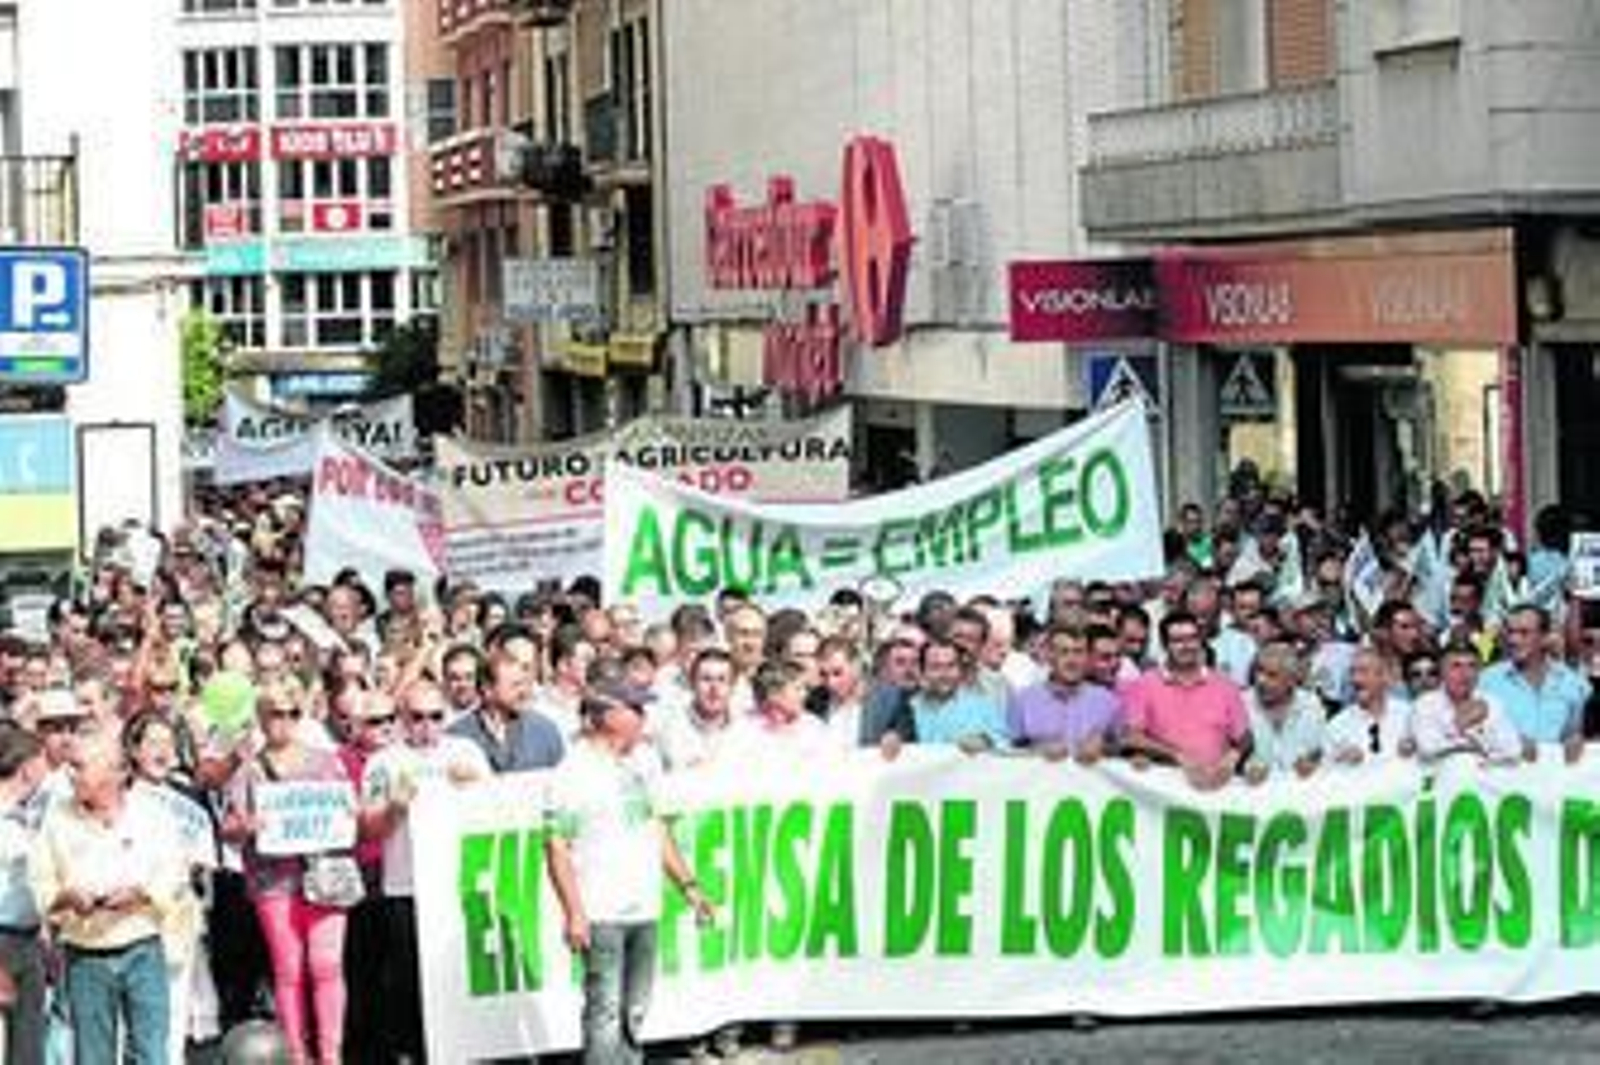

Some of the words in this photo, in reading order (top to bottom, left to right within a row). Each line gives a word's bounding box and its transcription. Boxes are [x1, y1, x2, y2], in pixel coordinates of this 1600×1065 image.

[11, 261, 67, 328] P
[453, 452, 591, 487] FUTURO
[621, 501, 813, 597] AGUA
[873, 447, 1131, 578] EMPLEO
[460, 830, 544, 997] EN
[884, 799, 978, 958] DE
[1003, 796, 1137, 959] LOS
[1163, 776, 1533, 958] REGADÍOS
